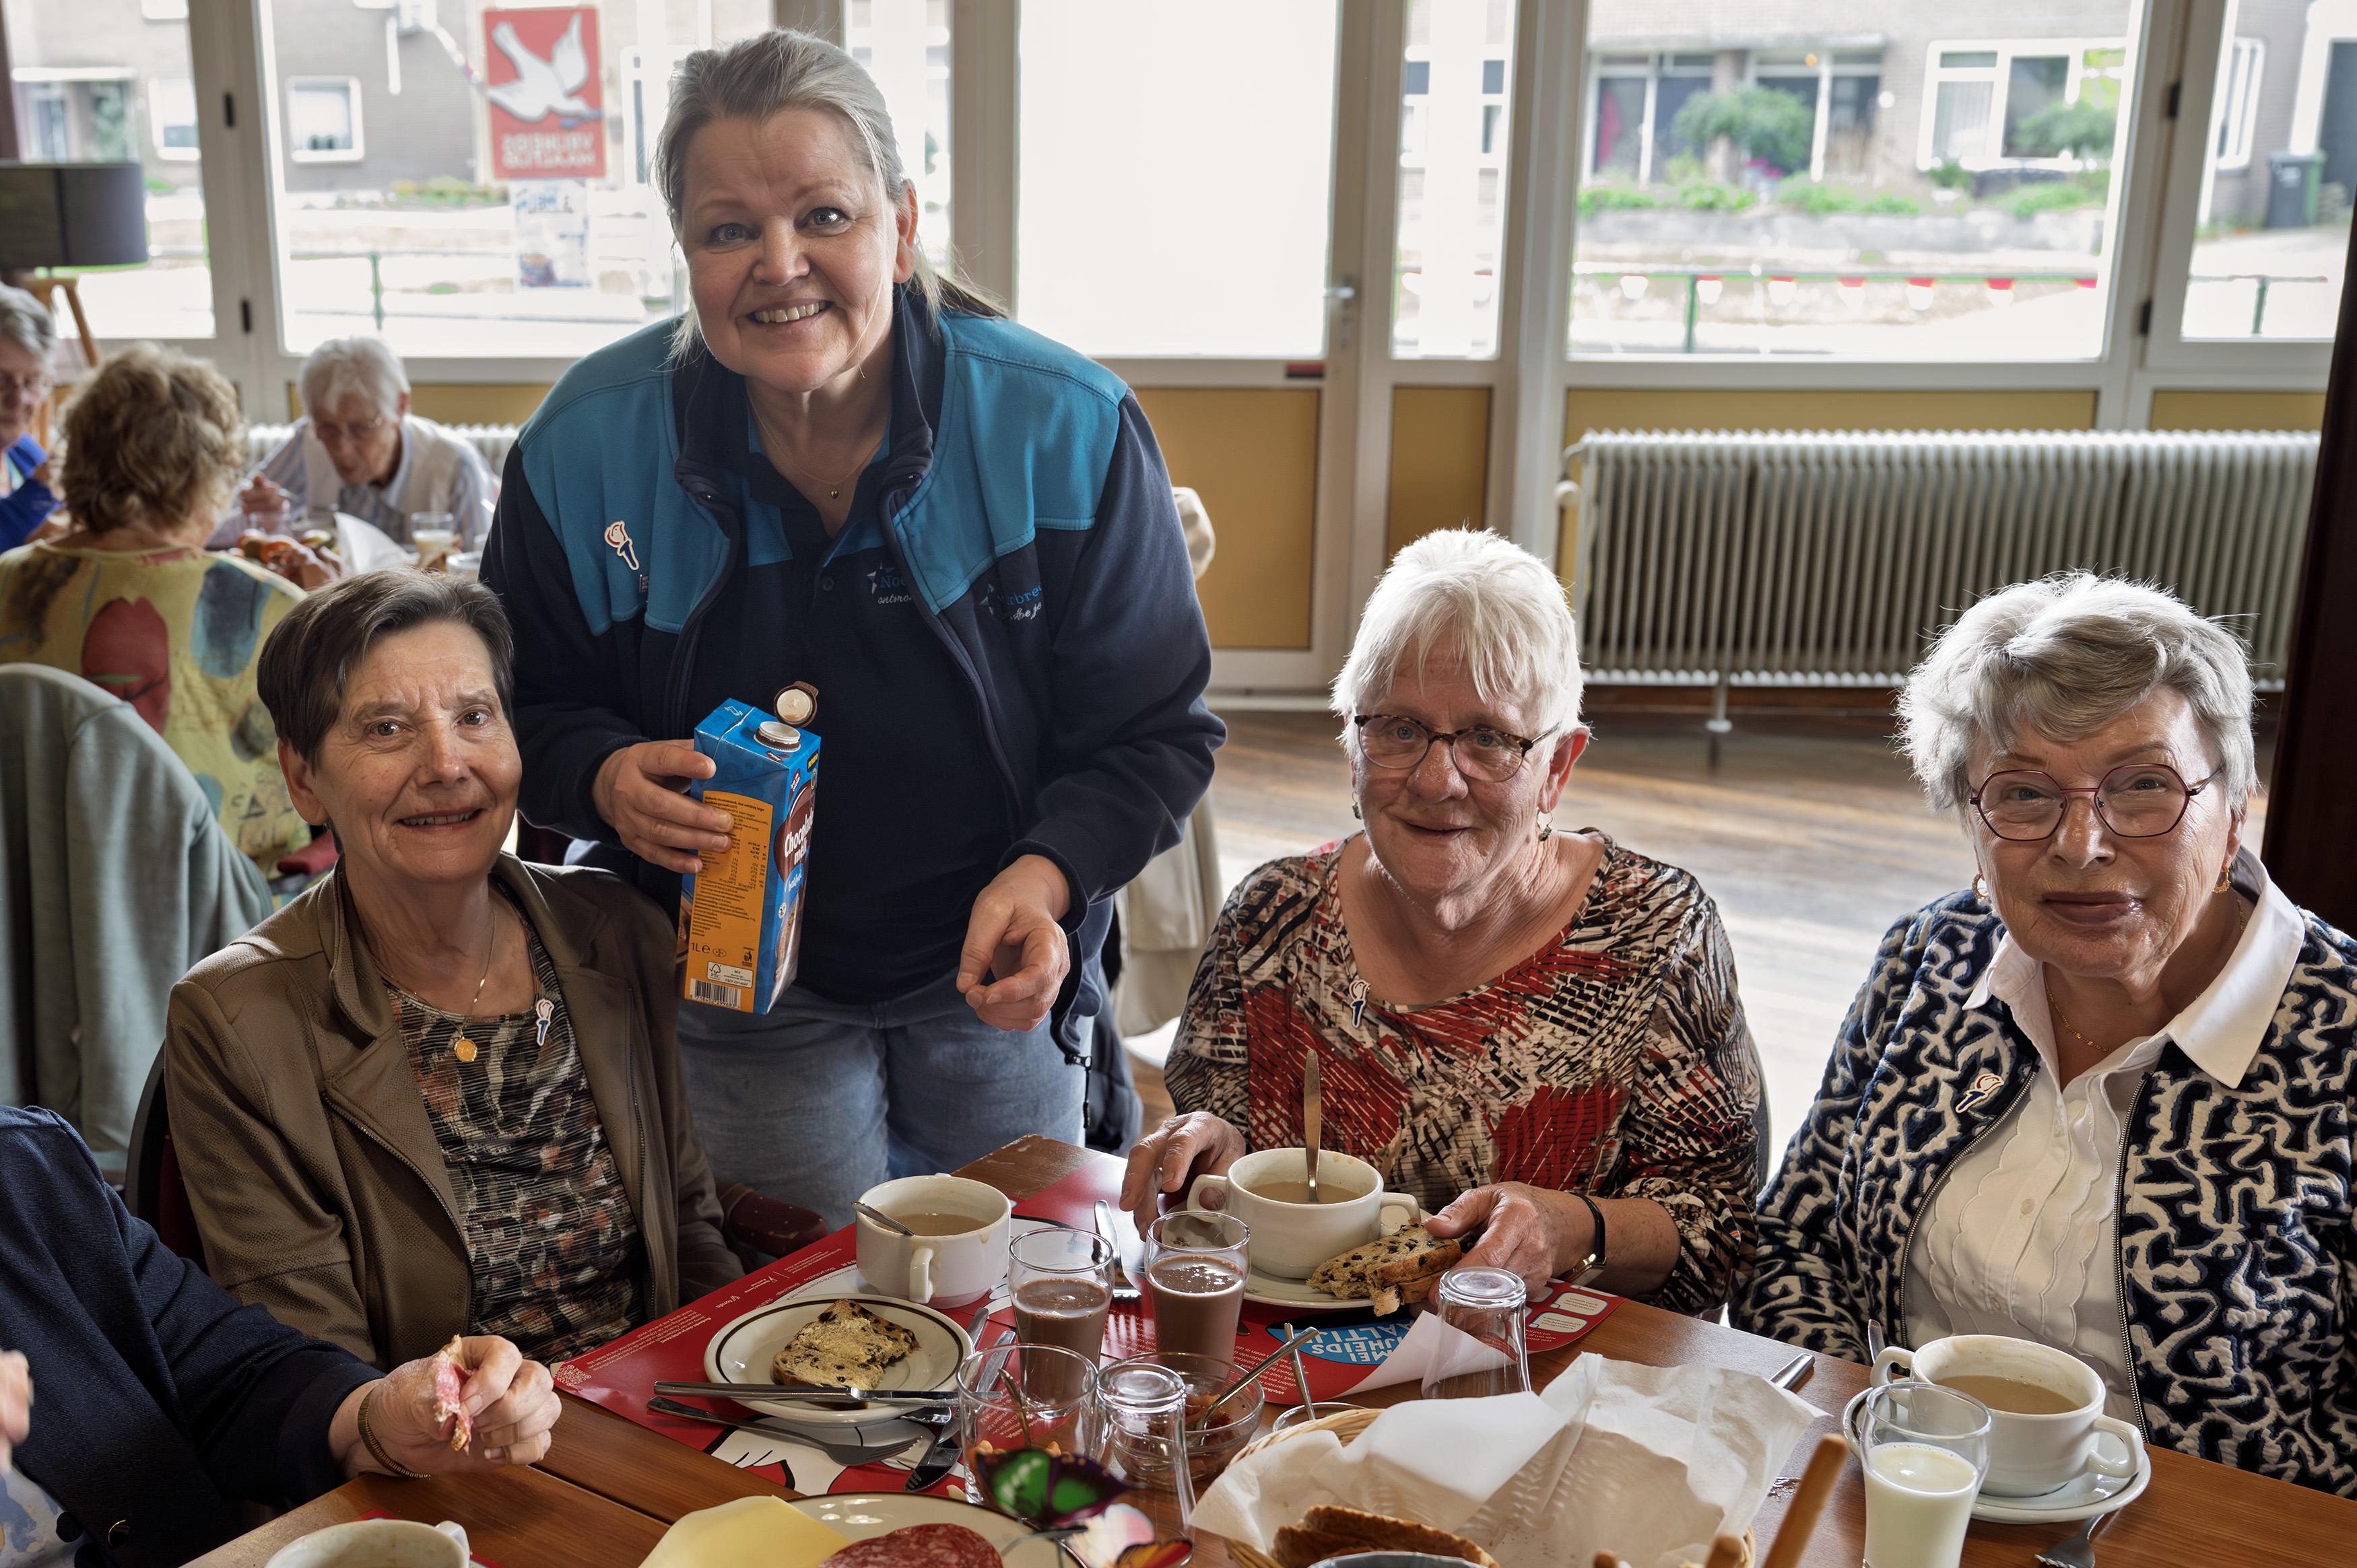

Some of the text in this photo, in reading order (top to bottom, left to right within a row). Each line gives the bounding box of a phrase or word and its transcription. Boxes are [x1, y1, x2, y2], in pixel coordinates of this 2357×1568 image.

[878, 593, 911, 605] ontmo
[1350, 1349, 1393, 1362] MEI
[1264, 1381, 1288, 1390] Samen
[1263, 1387, 1284, 1395] Welko
